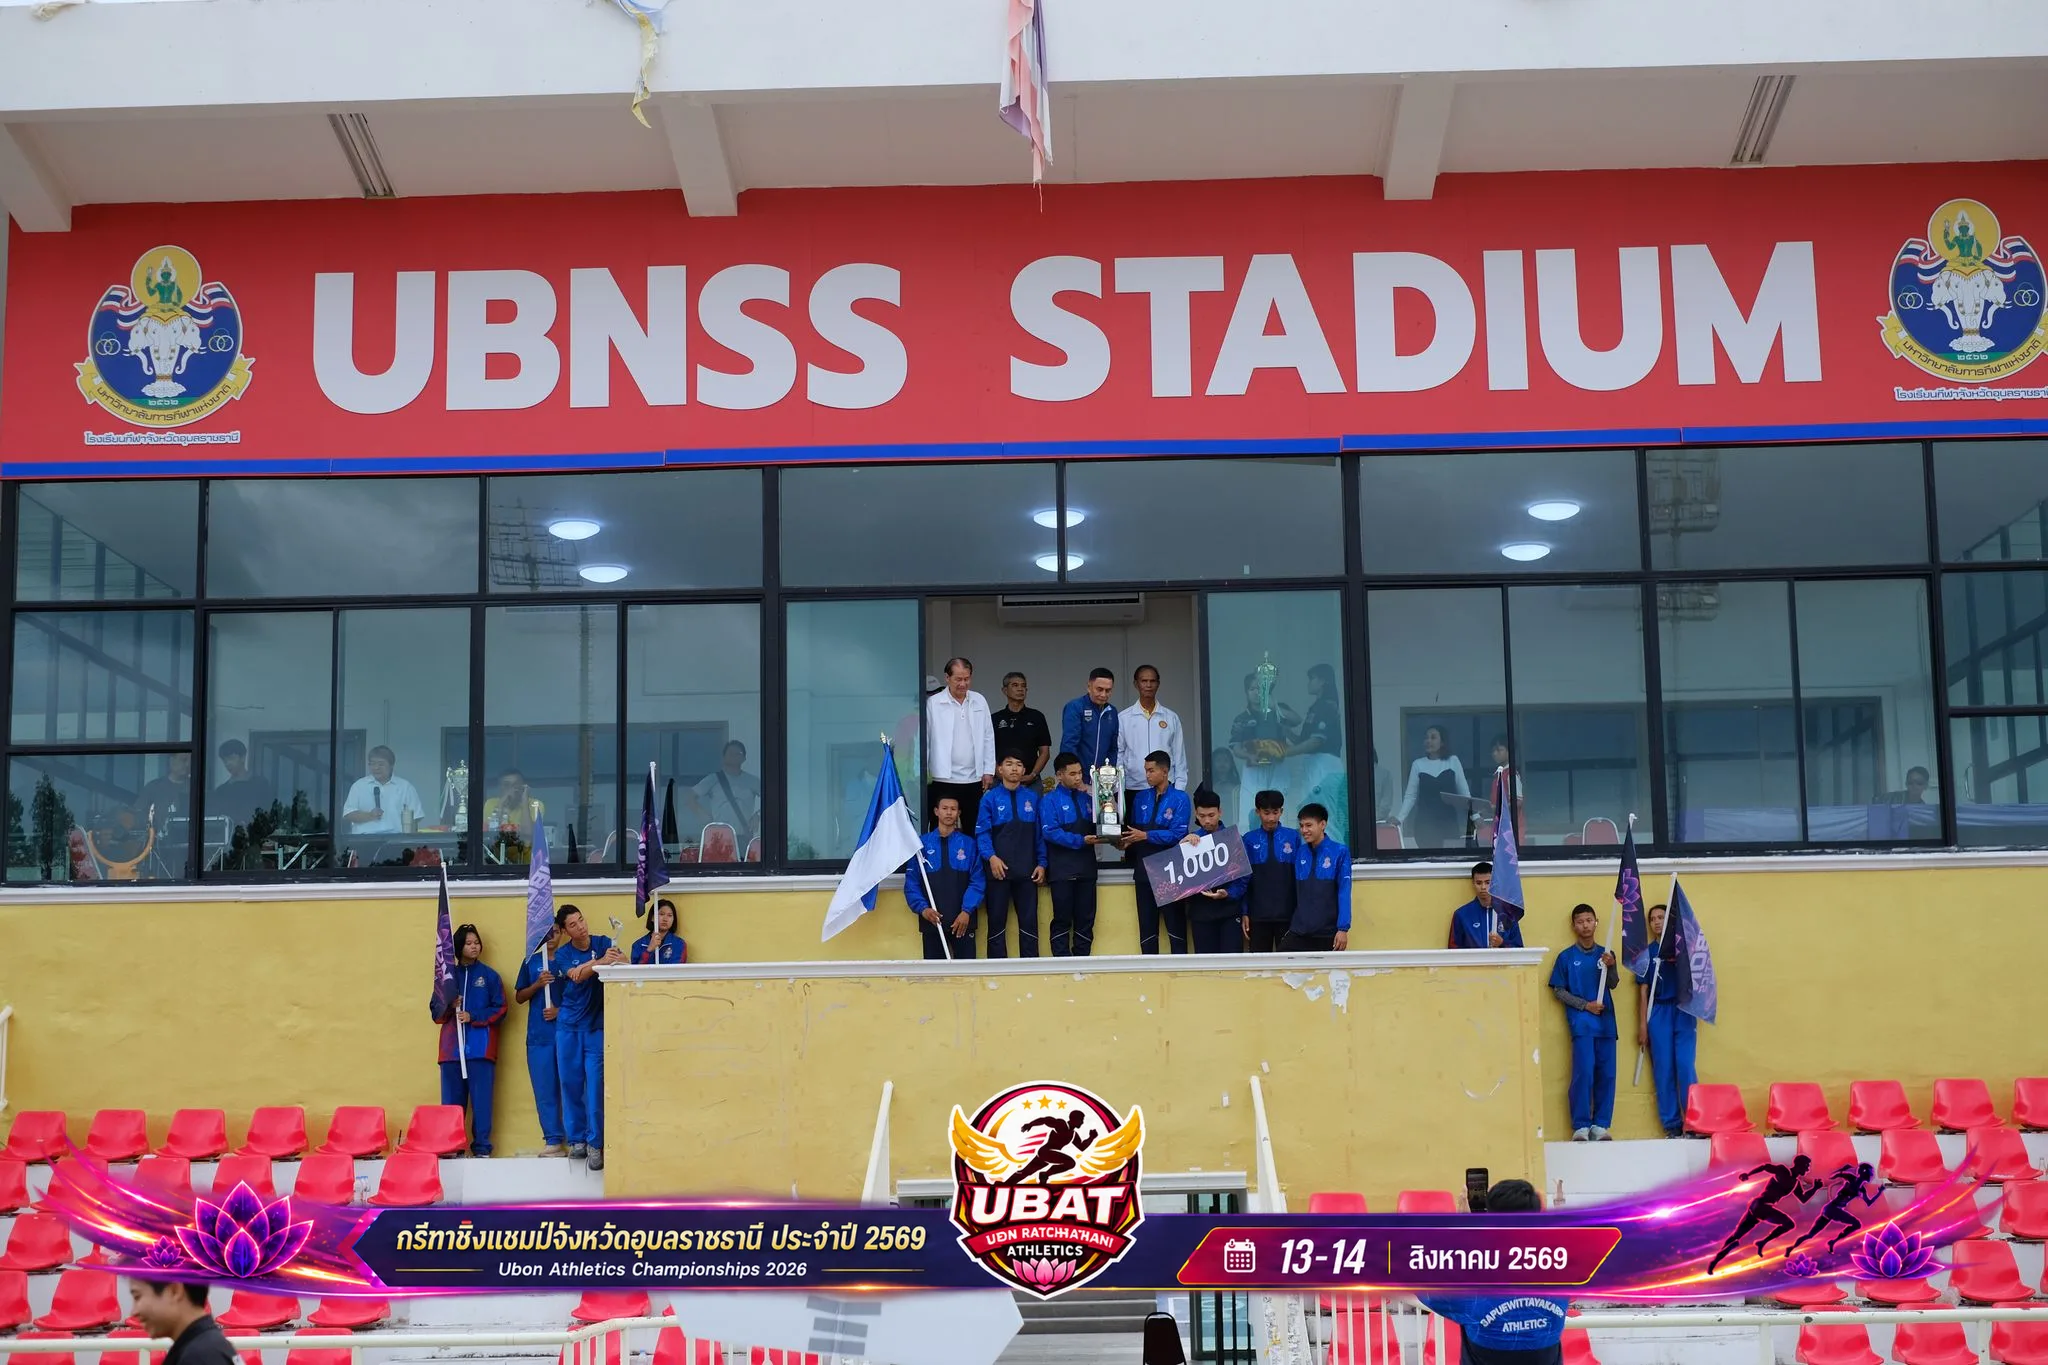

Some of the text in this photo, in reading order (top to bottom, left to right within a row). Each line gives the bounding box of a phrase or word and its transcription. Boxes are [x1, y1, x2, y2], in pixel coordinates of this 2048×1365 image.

[313, 240, 1822, 414] UBNSS STADIUM
[1163, 842, 1229, 885] 1,000
[1502, 1318, 1548, 1333] ATHLETICS
